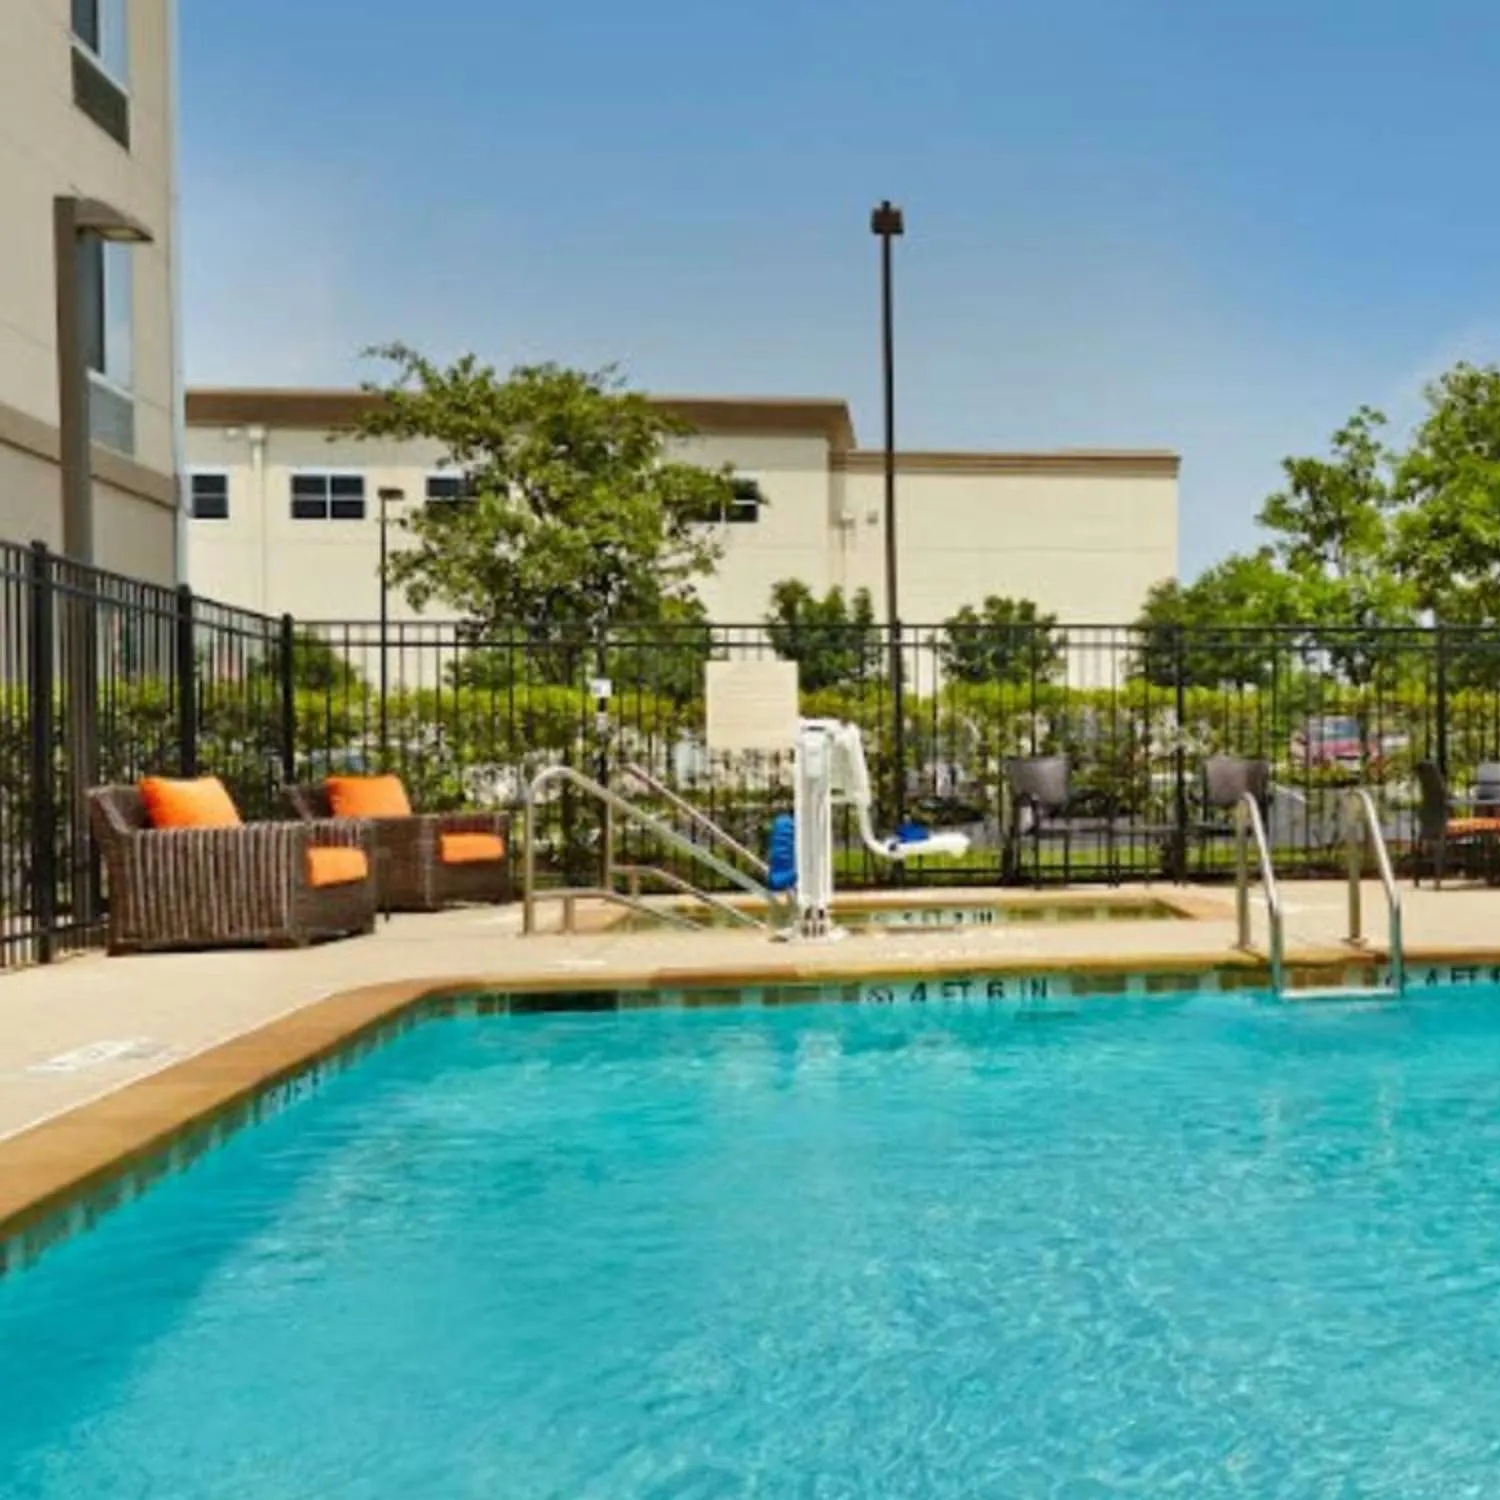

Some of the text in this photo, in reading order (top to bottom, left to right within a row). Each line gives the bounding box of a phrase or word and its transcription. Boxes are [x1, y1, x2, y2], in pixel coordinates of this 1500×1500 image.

[909, 981, 928, 1001] 4
[941, 979, 972, 1001] FT
[1019, 976, 1049, 1001] IN
